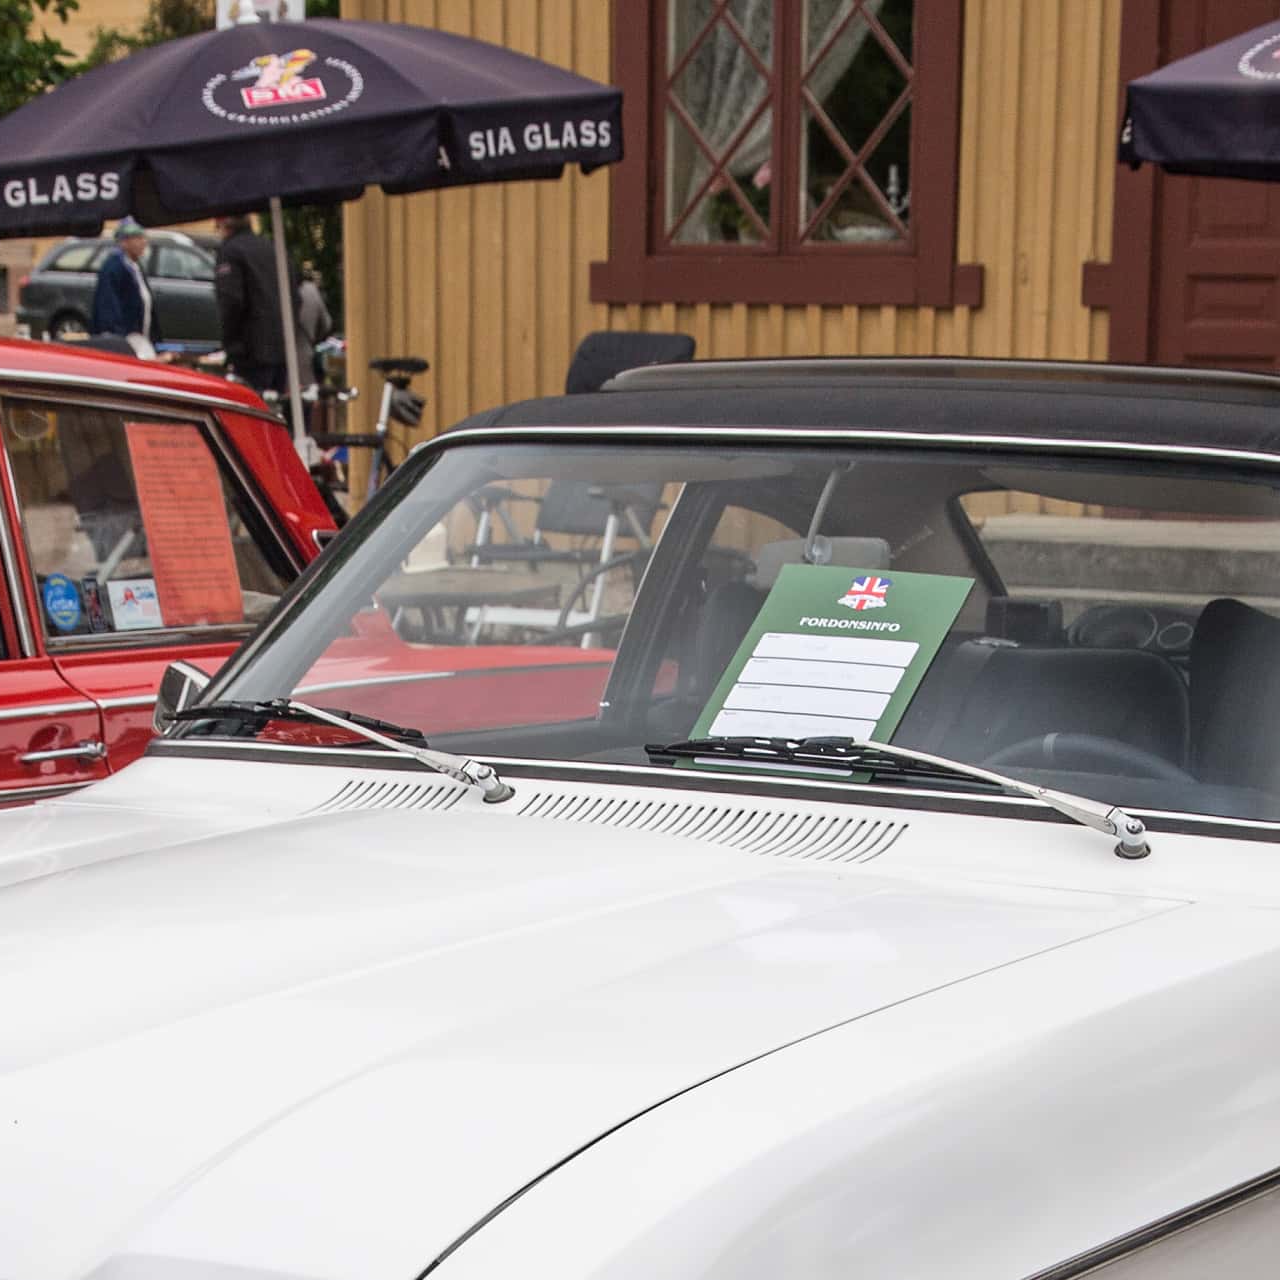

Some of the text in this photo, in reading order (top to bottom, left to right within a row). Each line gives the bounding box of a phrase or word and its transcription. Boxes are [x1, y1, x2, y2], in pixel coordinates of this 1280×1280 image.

[469, 120, 612, 160] SIA GLASS
[3, 172, 120, 208] GLASS
[799, 616, 901, 633] FORDONSINFO
